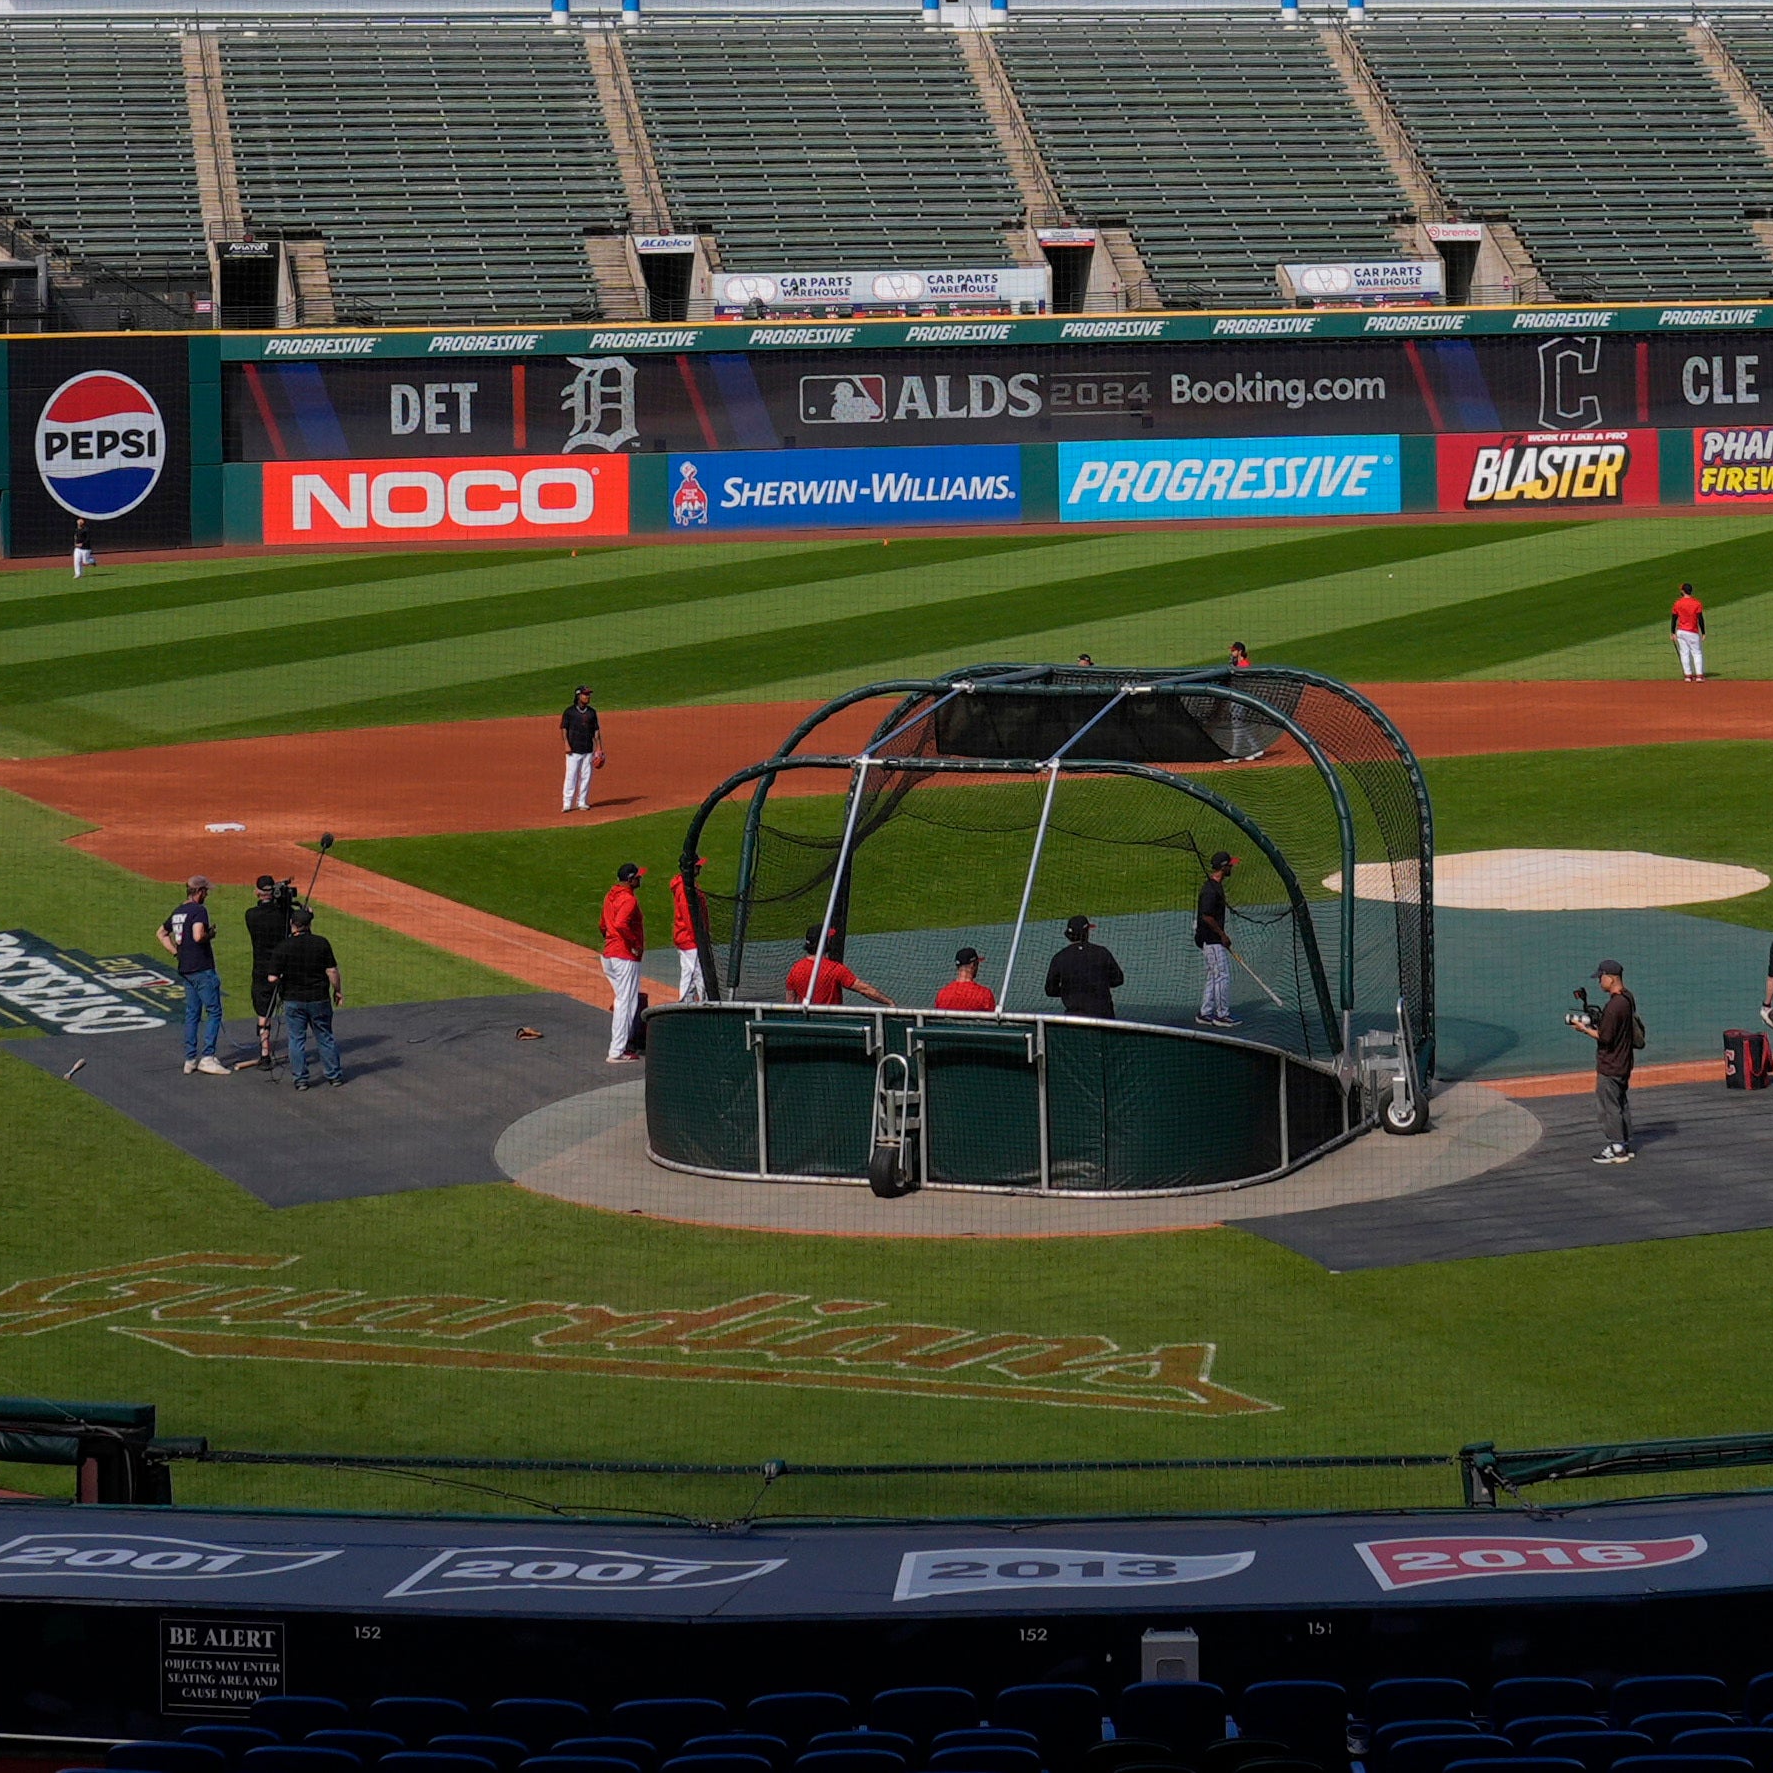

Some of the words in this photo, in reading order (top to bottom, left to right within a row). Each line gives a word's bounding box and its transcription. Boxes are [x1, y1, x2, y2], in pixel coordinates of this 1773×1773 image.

[1441, 227, 1480, 239] brembo
[641, 237, 692, 248] ACDelco
[927, 274, 956, 285] CAR
[958, 273, 999, 284] PARTS
[1354, 266, 1380, 278] CAR
[1383, 265, 1423, 277] PARTS
[780, 276, 808, 289] CAR
[811, 275, 852, 287] PARTS
[929, 283, 997, 294] WAREHOUSE
[1355, 276, 1421, 287] WAREHOUSE
[782, 287, 851, 297] WAREHOUSE
[1364, 315, 1467, 332] PROGRESSIVE
[1511, 311, 1614, 329] PROGRESSIVE
[1658, 309, 1758, 326] PROGRESSIVE
[904, 325, 1013, 342] PROGRESSIVE
[1060, 321, 1165, 339] PROGRESSIVE
[1212, 319, 1316, 335] PROGRESSIVE
[427, 334, 539, 353] PROGRESSIVE
[589, 331, 699, 349] PROGRESSIVE
[748, 328, 857, 345] PROGRESSIVE
[264, 337, 376, 356] PROGRESSIVE
[1537, 336, 1602, 431] C
[1682, 354, 1760, 406] CLE
[893, 372, 1043, 421] ALDS
[1050, 383, 1152, 406] 2024
[1170, 373, 1386, 410] Booking.com
[390, 380, 478, 437] DET
[43, 428, 157, 462] PEPSI
[1527, 432, 1559, 443] WORK
[1559, 432, 1571, 442] IT
[1571, 432, 1594, 442] LIKE
[1593, 432, 1604, 441] A
[1605, 431, 1628, 441] PRO
[1067, 454, 1380, 504] PROGRESSIVE
[1467, 444, 1626, 502] BLASTER
[721, 469, 1016, 509] SHERWIN-WILLIAMS
[290, 466, 596, 532] NOCO
[1390, 1542, 1649, 1574] 2016
[439, 1557, 713, 1585] 2007
[926, 1558, 1179, 1581] 2013
[169, 1626, 198, 1646] BE
[202, 1628, 276, 1651] ALERT
[353, 1624, 382, 1640] 152
[1017, 1627, 1048, 1642] 152
[164, 1657, 211, 1672] OBJECTS
[214, 1659, 238, 1672] MAY
[240, 1661, 282, 1674] ENTER
[166, 1672, 217, 1686] SEATING
[219, 1673, 250, 1686] AREA
[251, 1674, 278, 1687] AND
[181, 1686, 217, 1699] CAUSE
